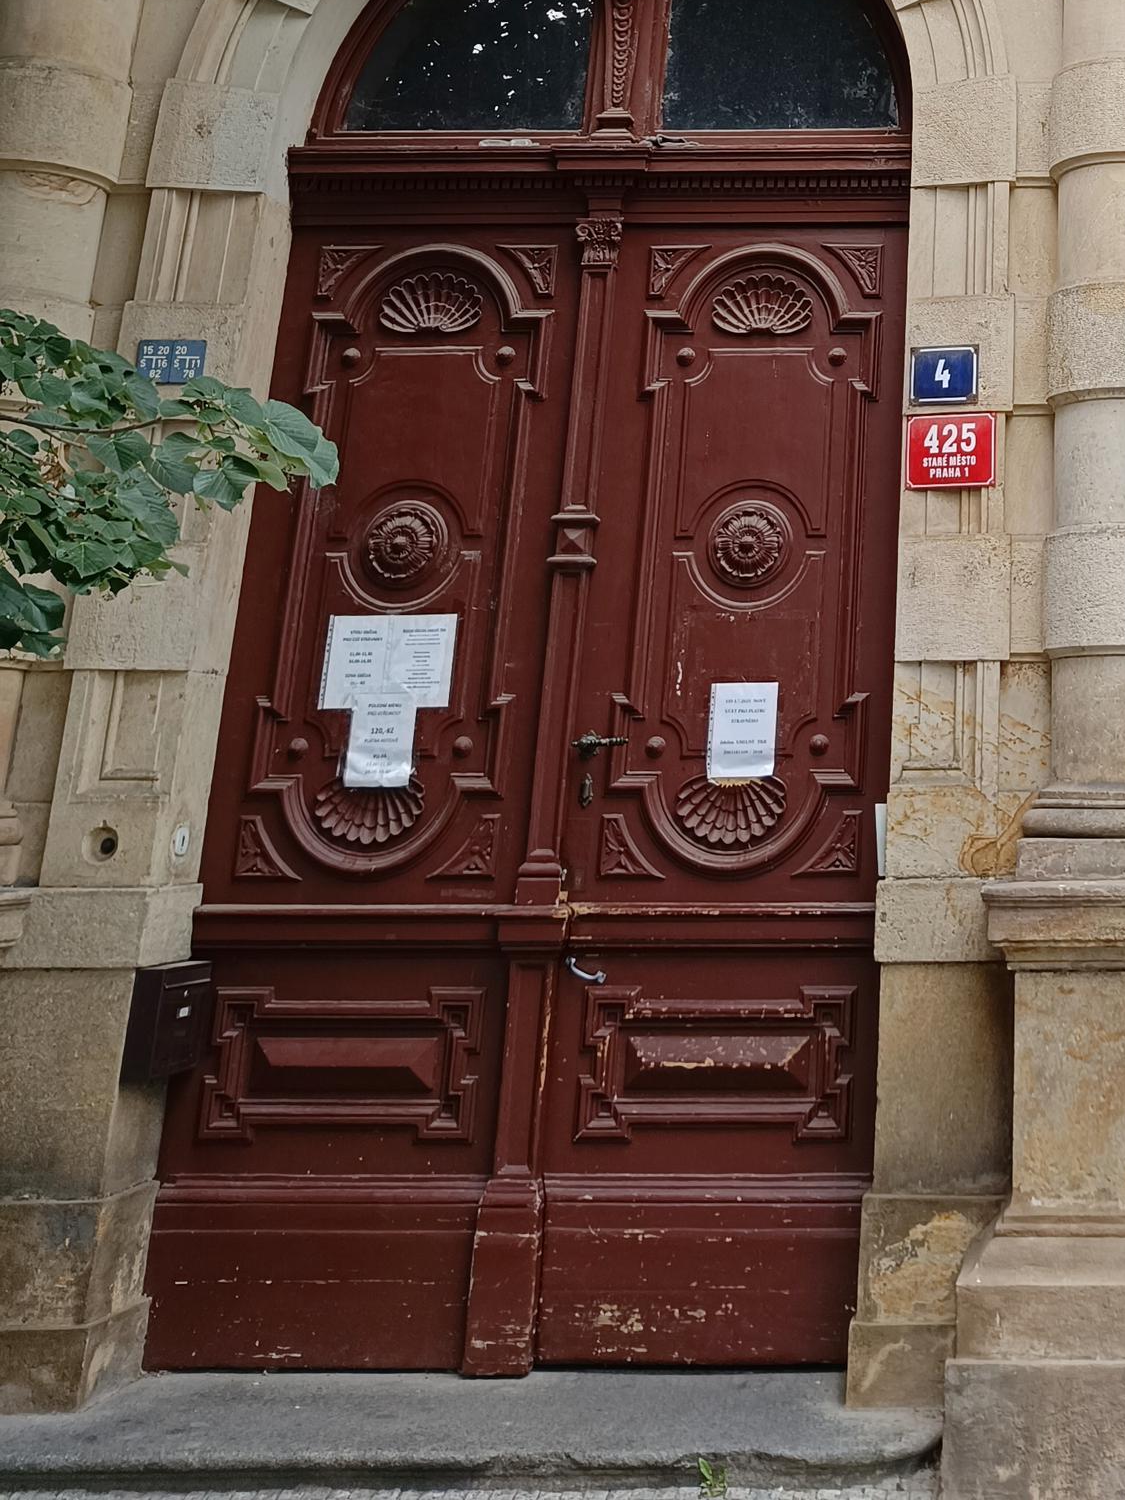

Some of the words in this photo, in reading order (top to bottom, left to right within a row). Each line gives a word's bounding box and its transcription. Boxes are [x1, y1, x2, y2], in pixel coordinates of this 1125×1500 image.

[934, 358, 951, 389] 4
[923, 422, 977, 454] 425
[922, 454, 948, 468] STARÉ
[949, 453, 977, 466] MĚSTO
[929, 467, 961, 479] PRAHA
[963, 467, 969, 477] 1
